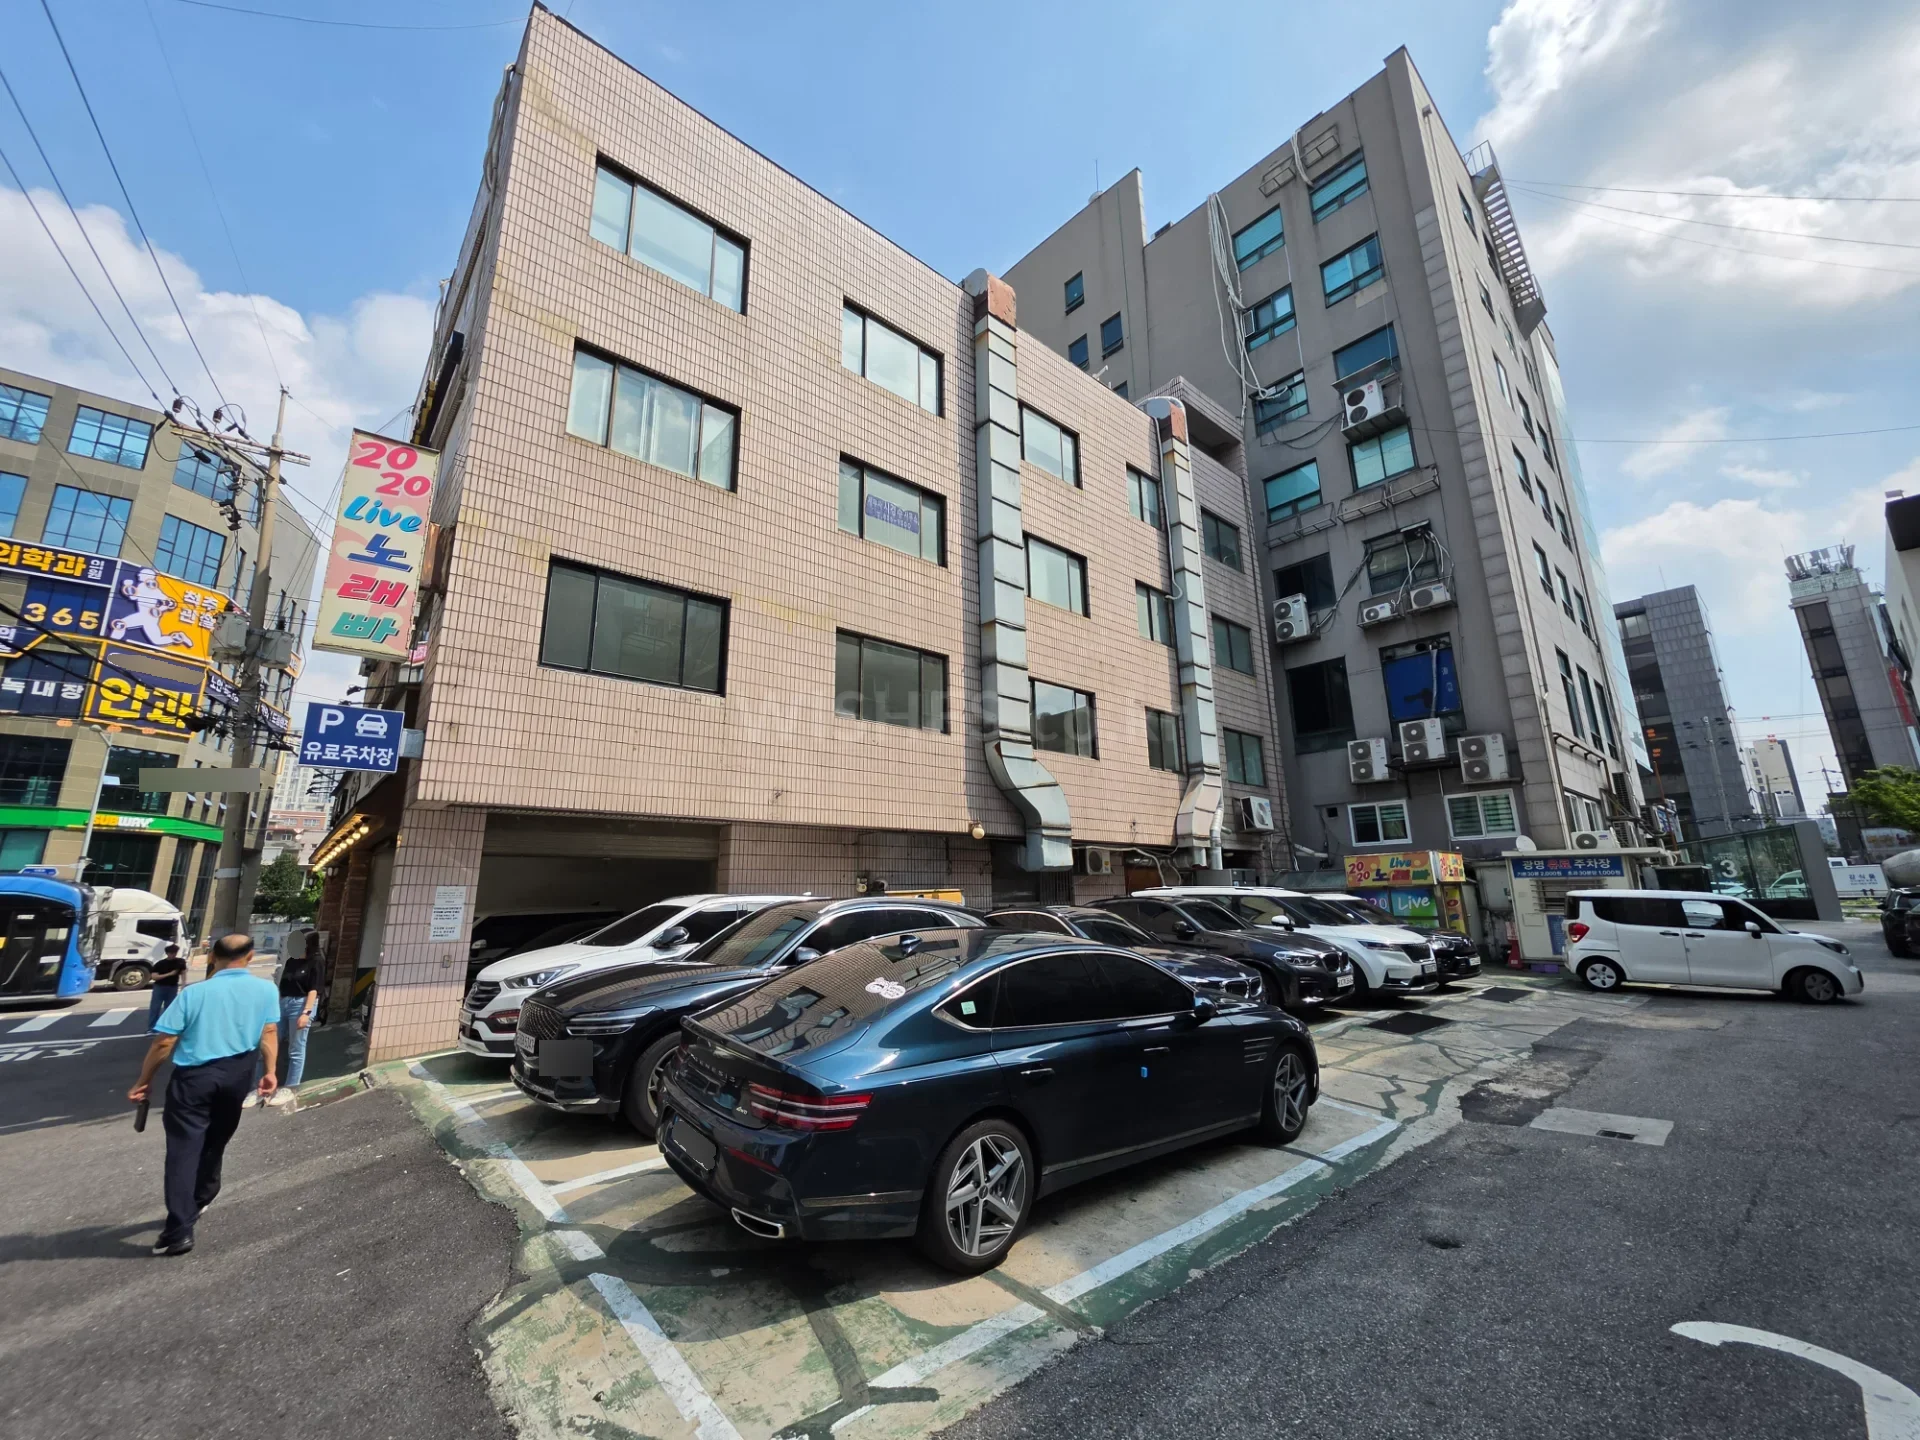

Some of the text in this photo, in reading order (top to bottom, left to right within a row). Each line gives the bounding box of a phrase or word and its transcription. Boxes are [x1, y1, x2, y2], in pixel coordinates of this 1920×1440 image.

[351, 440, 419, 471] 20
[375, 471, 431, 497] 20
[343, 495, 423, 534] Live
[23, 602, 100, 630] 365
[98, 677, 194, 729] 안과
[318, 708, 345, 735] P
[303, 740, 394, 767] 유료주차장
[93, 813, 155, 829] SUBWAY
[1348, 861, 1364, 874] 20
[1389, 856, 1412, 868] Live
[1522, 857, 1611, 870] 광명 유료 주차장
[1719, 859, 1737, 878] 3
[1356, 870, 1371, 882] 20
[1397, 894, 1431, 911] Live
